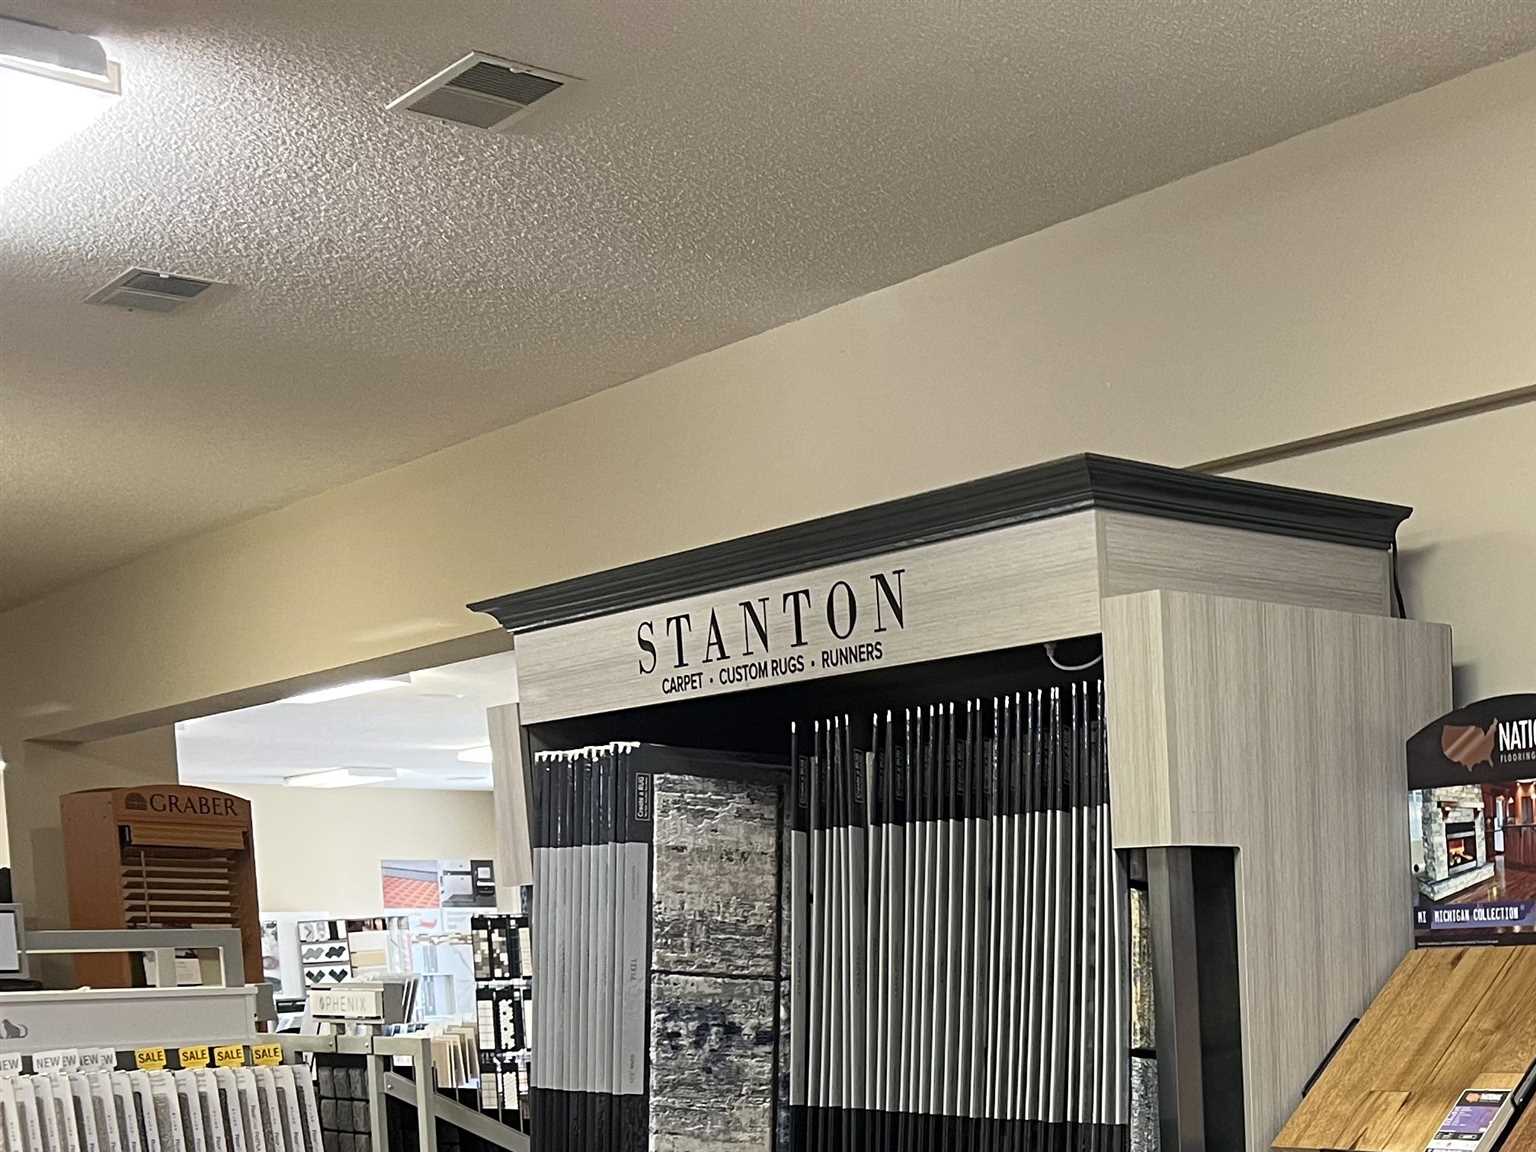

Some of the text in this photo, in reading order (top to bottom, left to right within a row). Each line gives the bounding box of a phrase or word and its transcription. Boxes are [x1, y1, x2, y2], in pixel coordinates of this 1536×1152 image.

[637, 568, 906, 675] STANTON
[662, 641, 883, 695] CARPET CUSTOM RUGS RUNNERS
[1499, 750, 1536, 764] FLOORING
[149, 793, 238, 816] GRABER
[1434, 906, 1519, 923] MICHIGAN COLLECTION
[326, 995, 367, 1012] PHENIX
[138, 1050, 164, 1064] SALE
[182, 1048, 207, 1062] SALE
[217, 1047, 242, 1062] SALE
[254, 1046, 280, 1061] SALE
[36, 1055, 61, 1068] NEW
